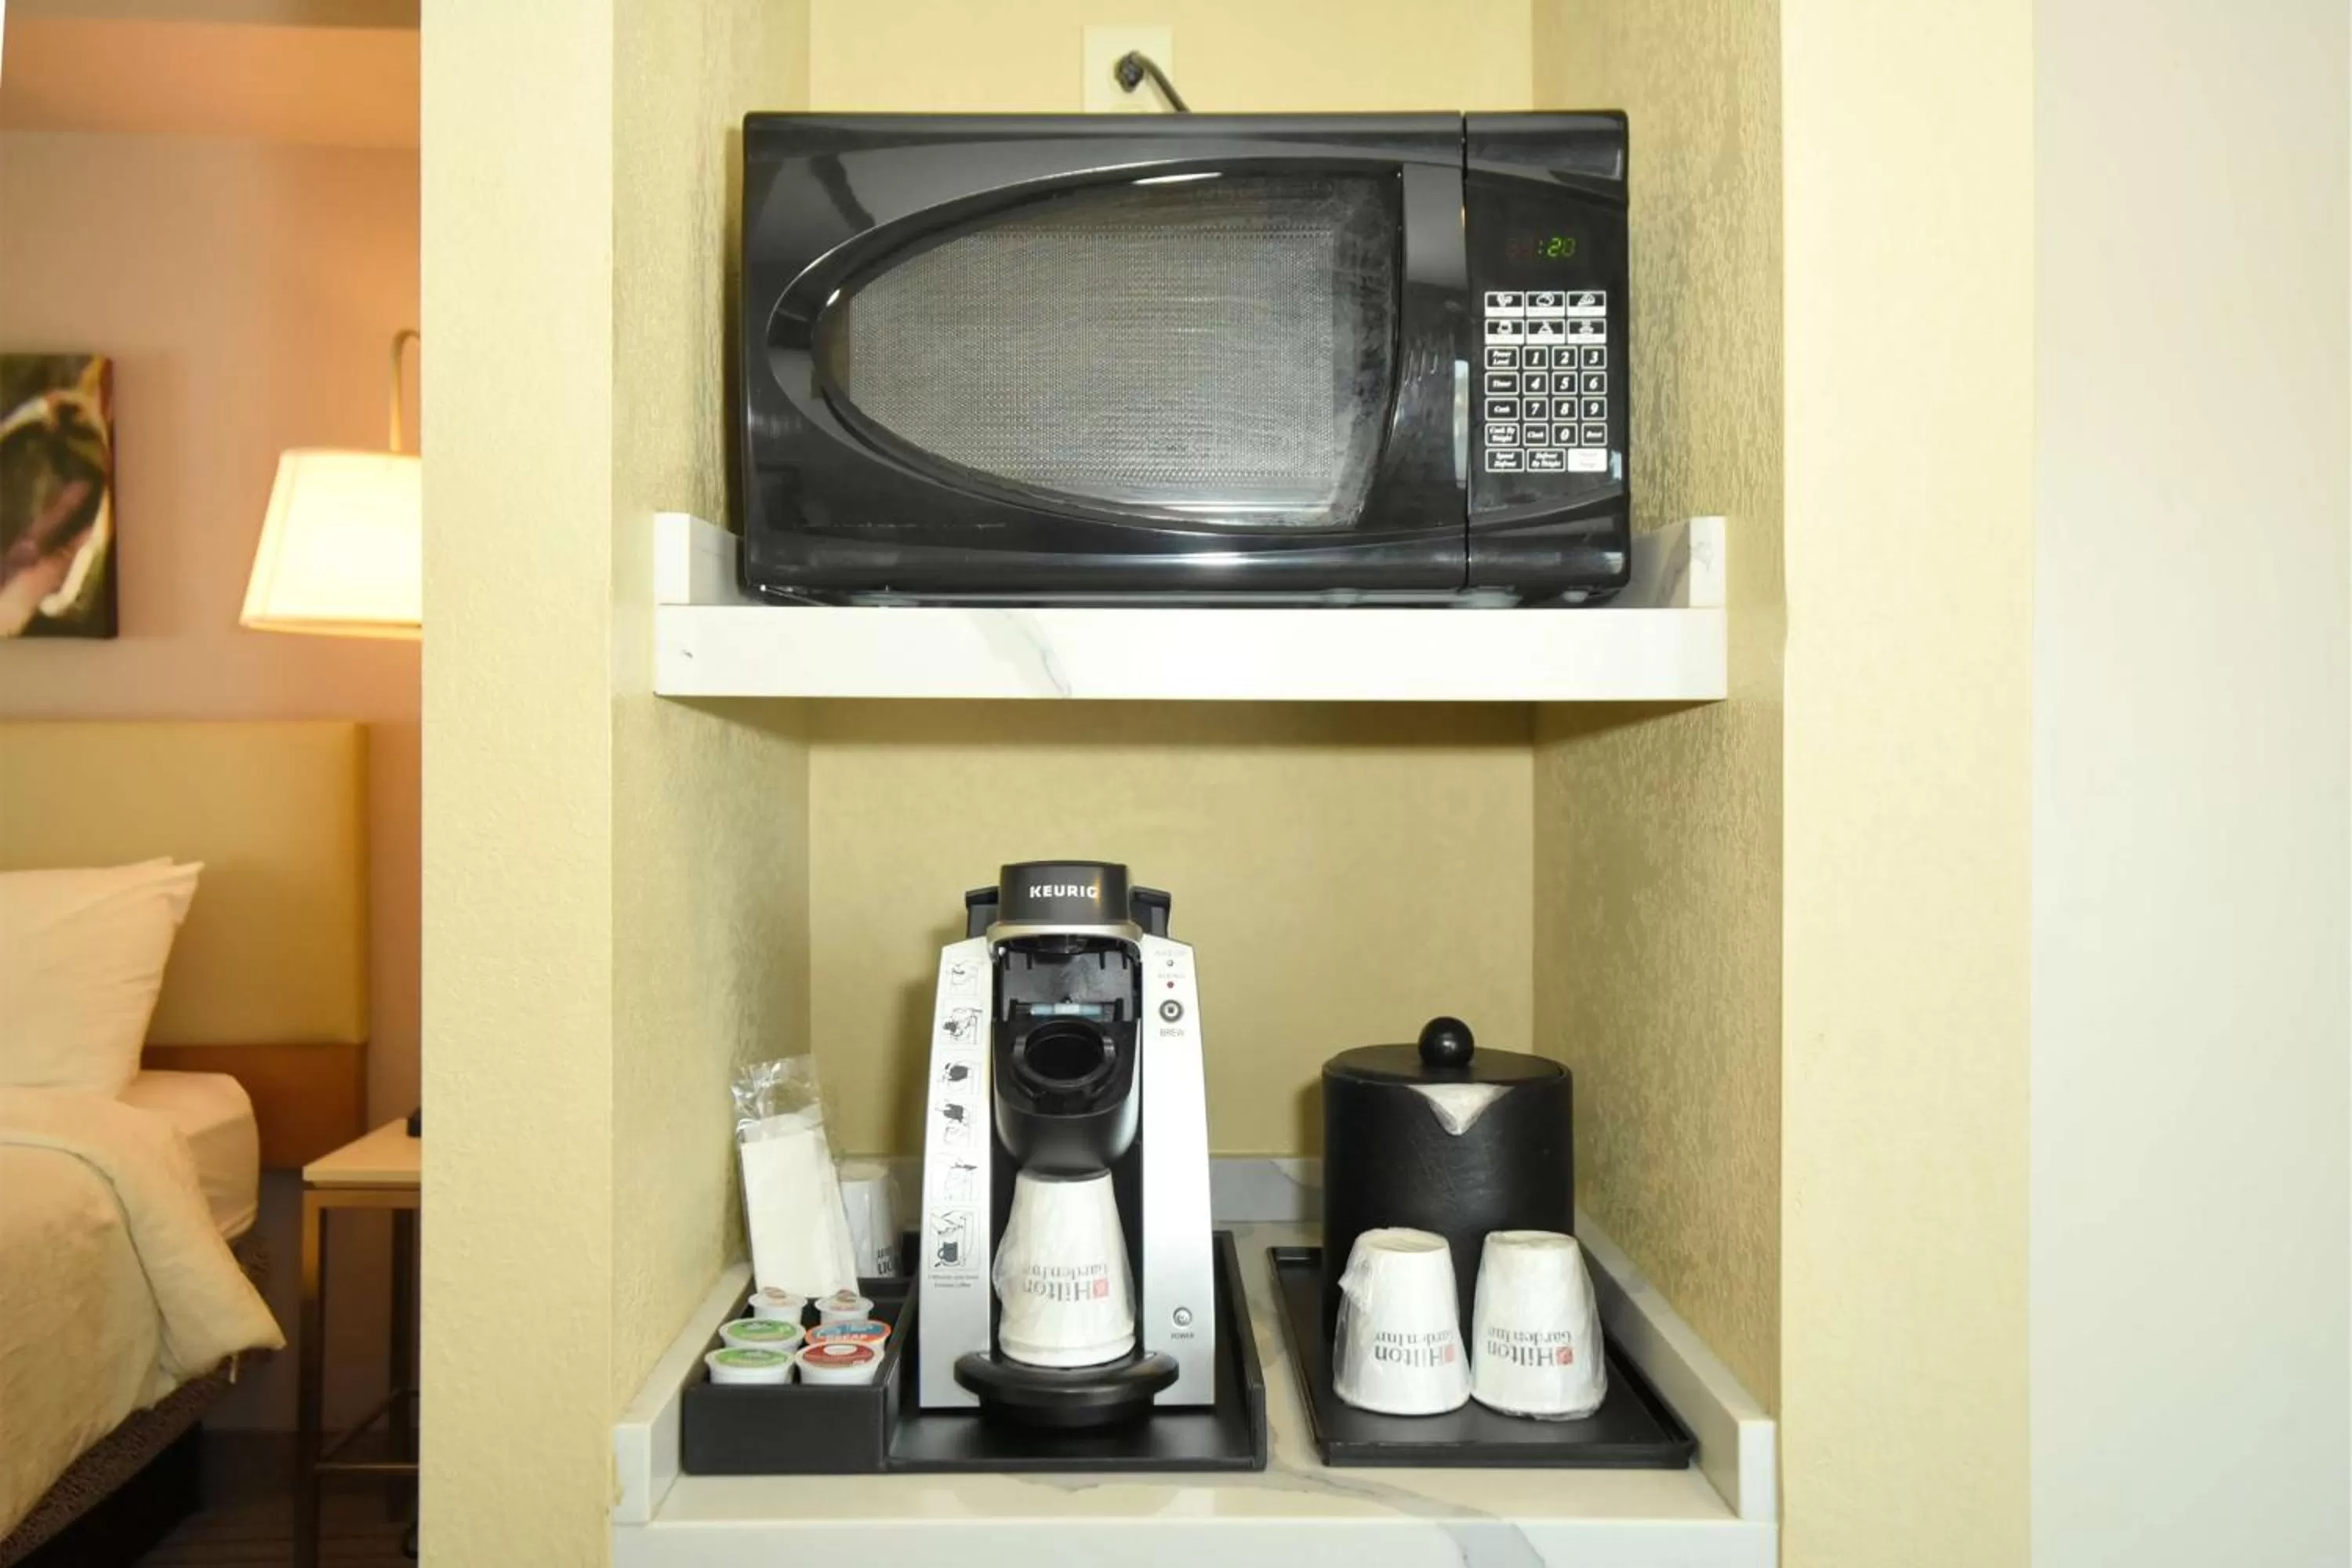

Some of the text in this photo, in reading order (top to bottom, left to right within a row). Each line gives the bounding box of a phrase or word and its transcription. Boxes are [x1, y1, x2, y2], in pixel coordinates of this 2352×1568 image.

[1531, 351, 1540, 365] 1
[1560, 350, 1570, 365] 2
[1589, 350, 1599, 365] 3
[1530, 376, 1541, 390] 4
[1559, 376, 1570, 390] 5
[1589, 376, 1599, 390] 6
[1531, 402, 1541, 416] 7
[1560, 402, 1570, 416] 8
[1590, 402, 1599, 416] 9
[1560, 428, 1570, 441] 0
[1029, 884, 1100, 898] KEURIG
[1022, 1279, 1091, 1302] Hilton
[1375, 1345, 1444, 1368] Hilton
[1487, 1341, 1554, 1367] Hilton
